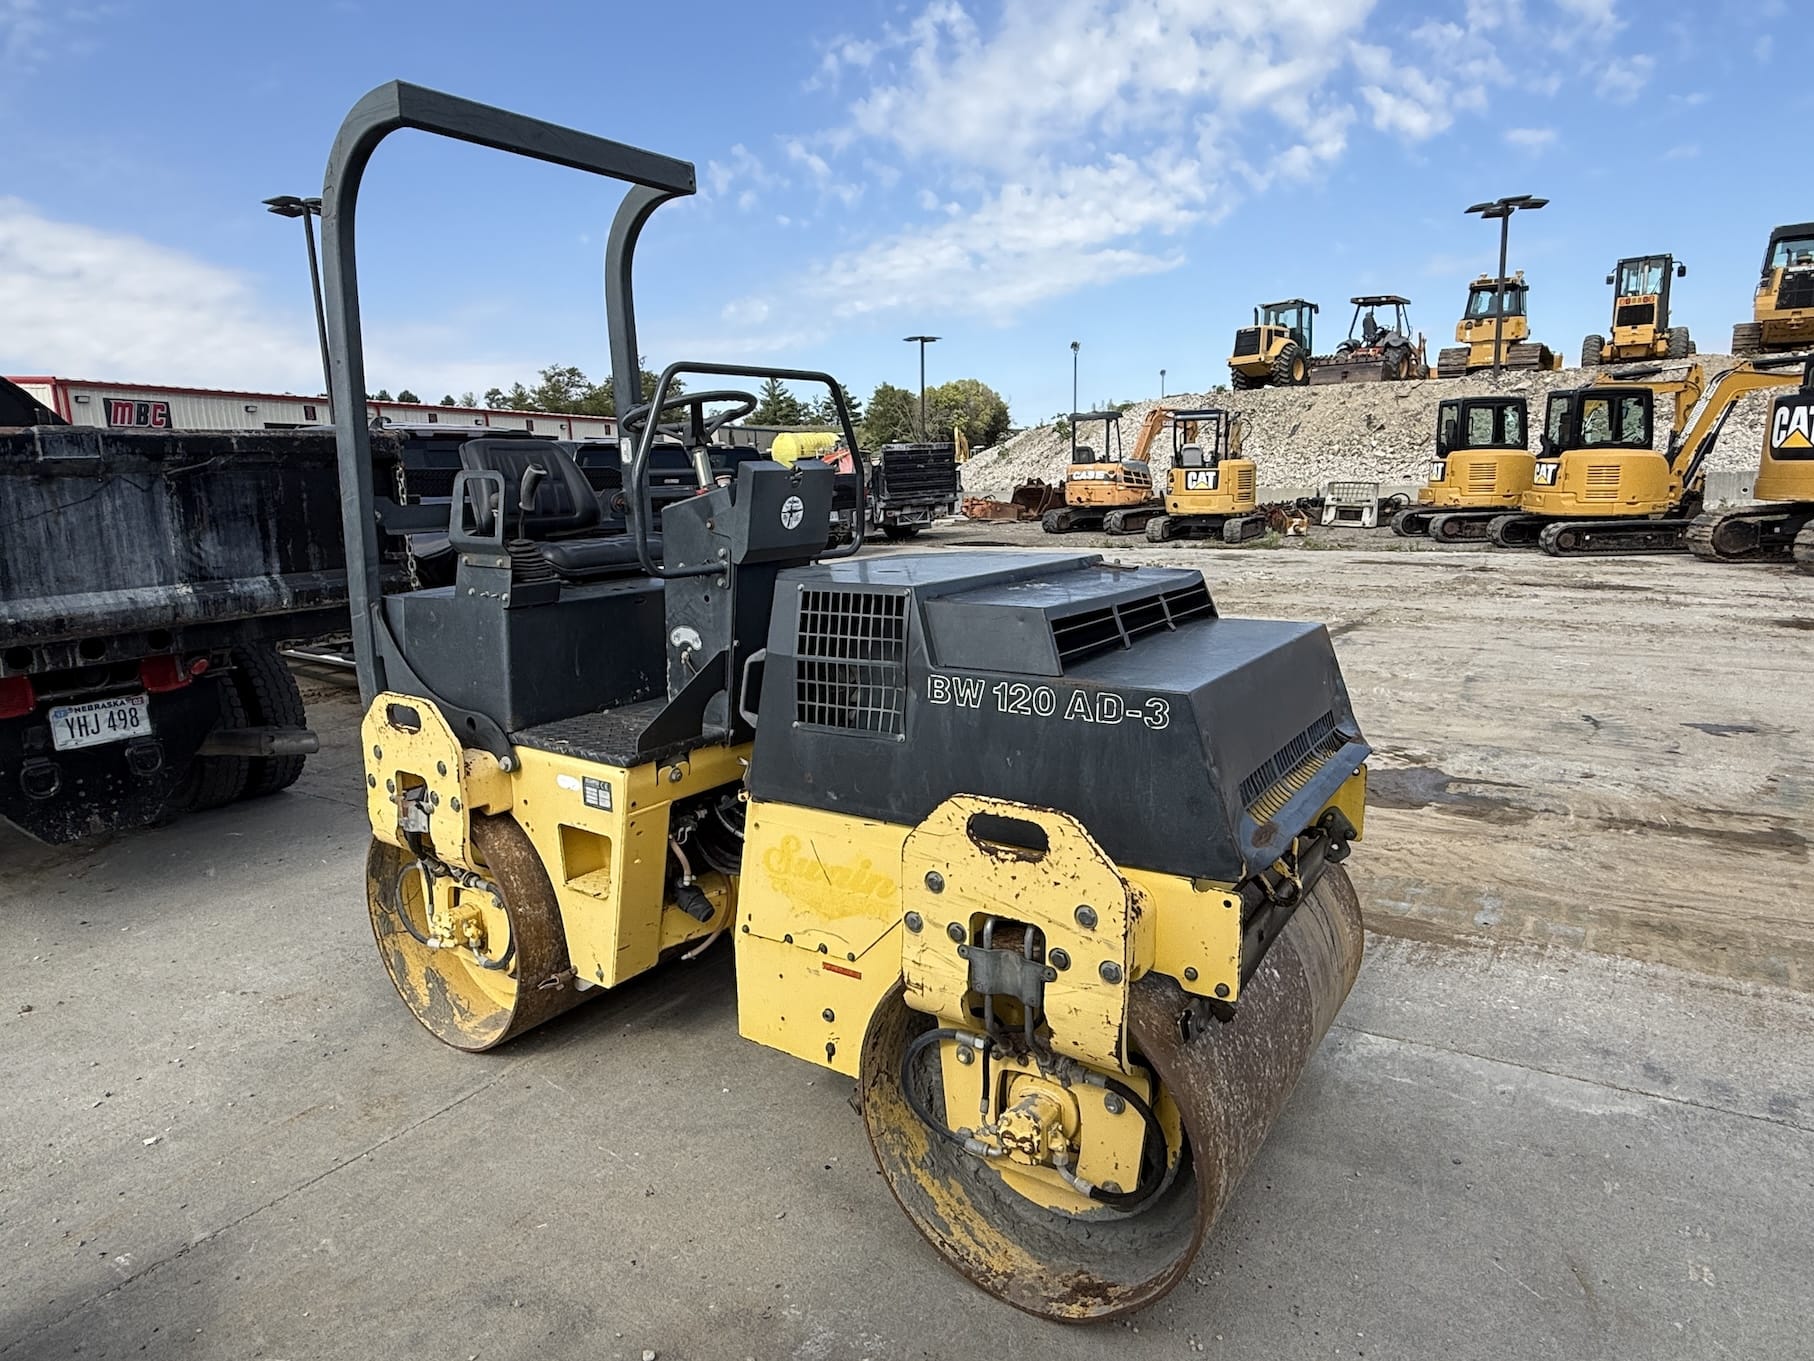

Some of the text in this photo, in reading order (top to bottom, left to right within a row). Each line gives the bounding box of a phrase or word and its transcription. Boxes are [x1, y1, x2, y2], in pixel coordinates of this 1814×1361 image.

[110, 400, 167, 428] MBC
[1772, 406, 1814, 448] CA
[1072, 471, 1105, 480] CASE
[1187, 472, 1216, 490] CAT
[74, 699, 128, 714] NEBRASKA
[928, 674, 1170, 729] BW 120 AD-3
[65, 707, 140, 739] YHJ 498
